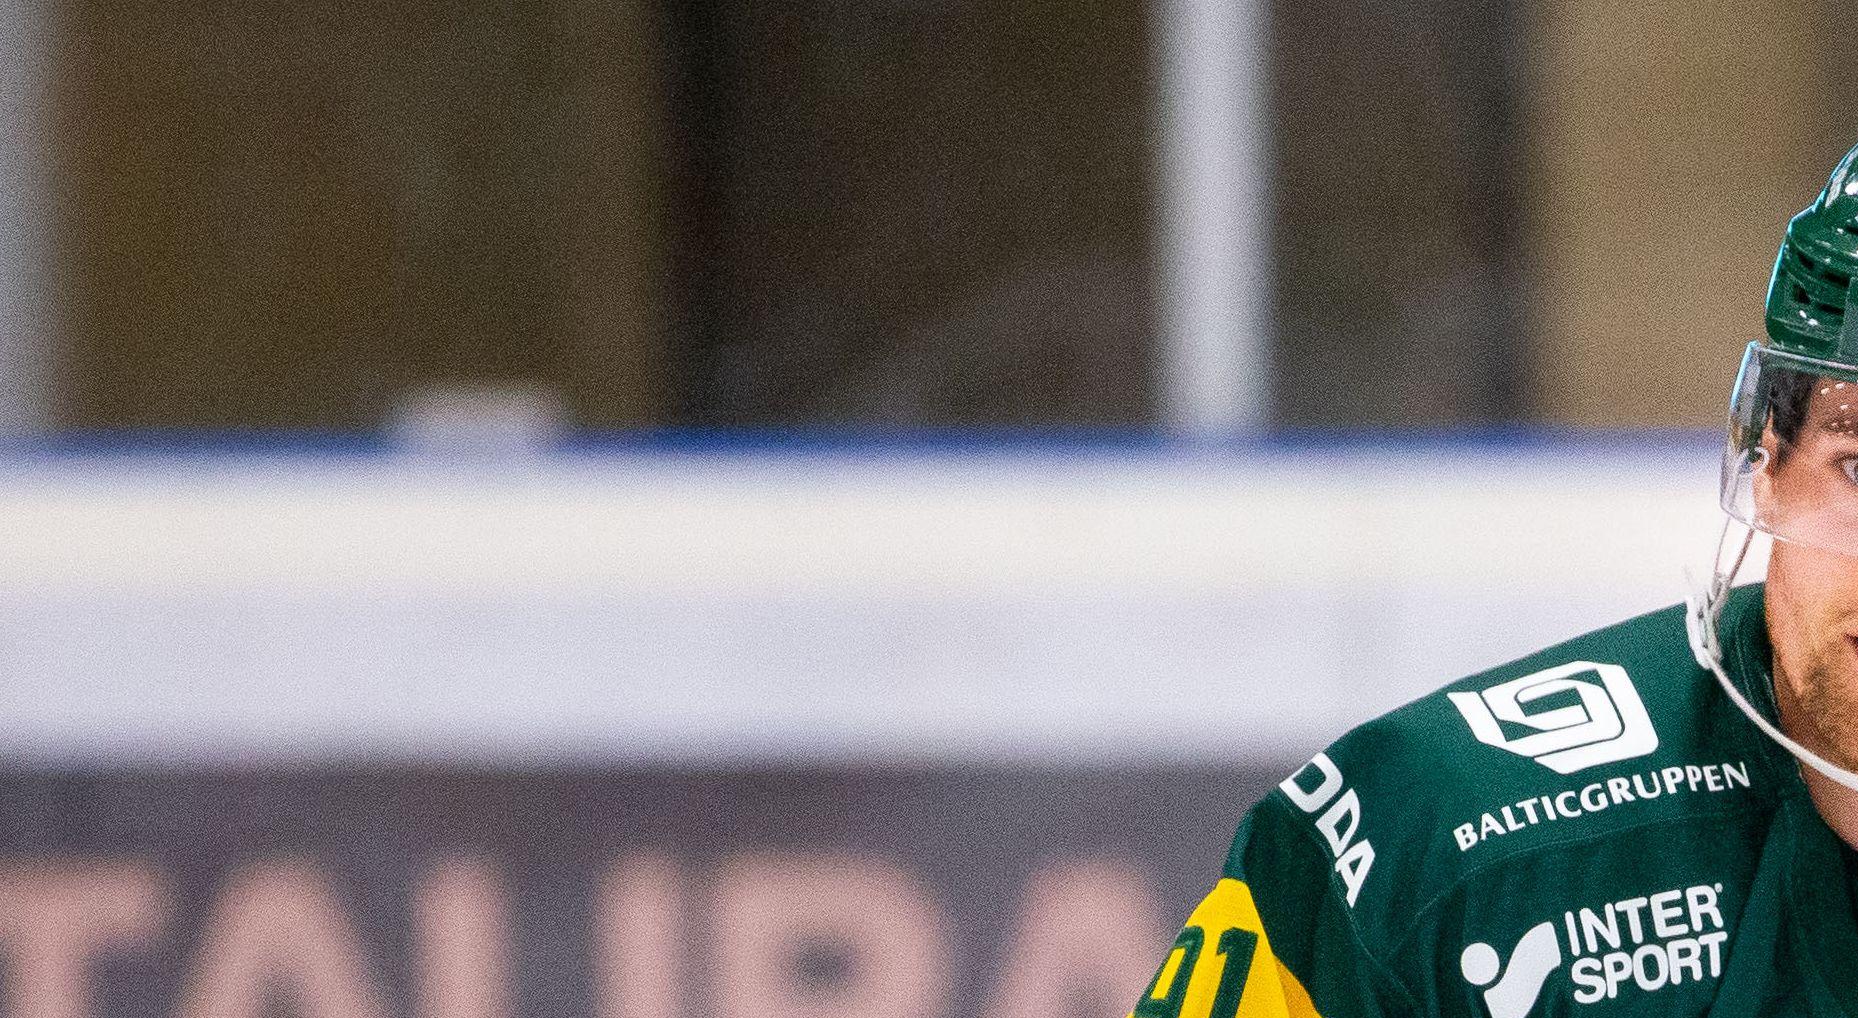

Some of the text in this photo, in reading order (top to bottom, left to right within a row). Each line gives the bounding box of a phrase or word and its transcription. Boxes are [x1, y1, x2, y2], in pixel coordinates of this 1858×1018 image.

[1452, 761, 1751, 852] BALTICGRUPPEN
[1564, 882, 1725, 957] INTER
[1570, 931, 1728, 1005] SPORT
